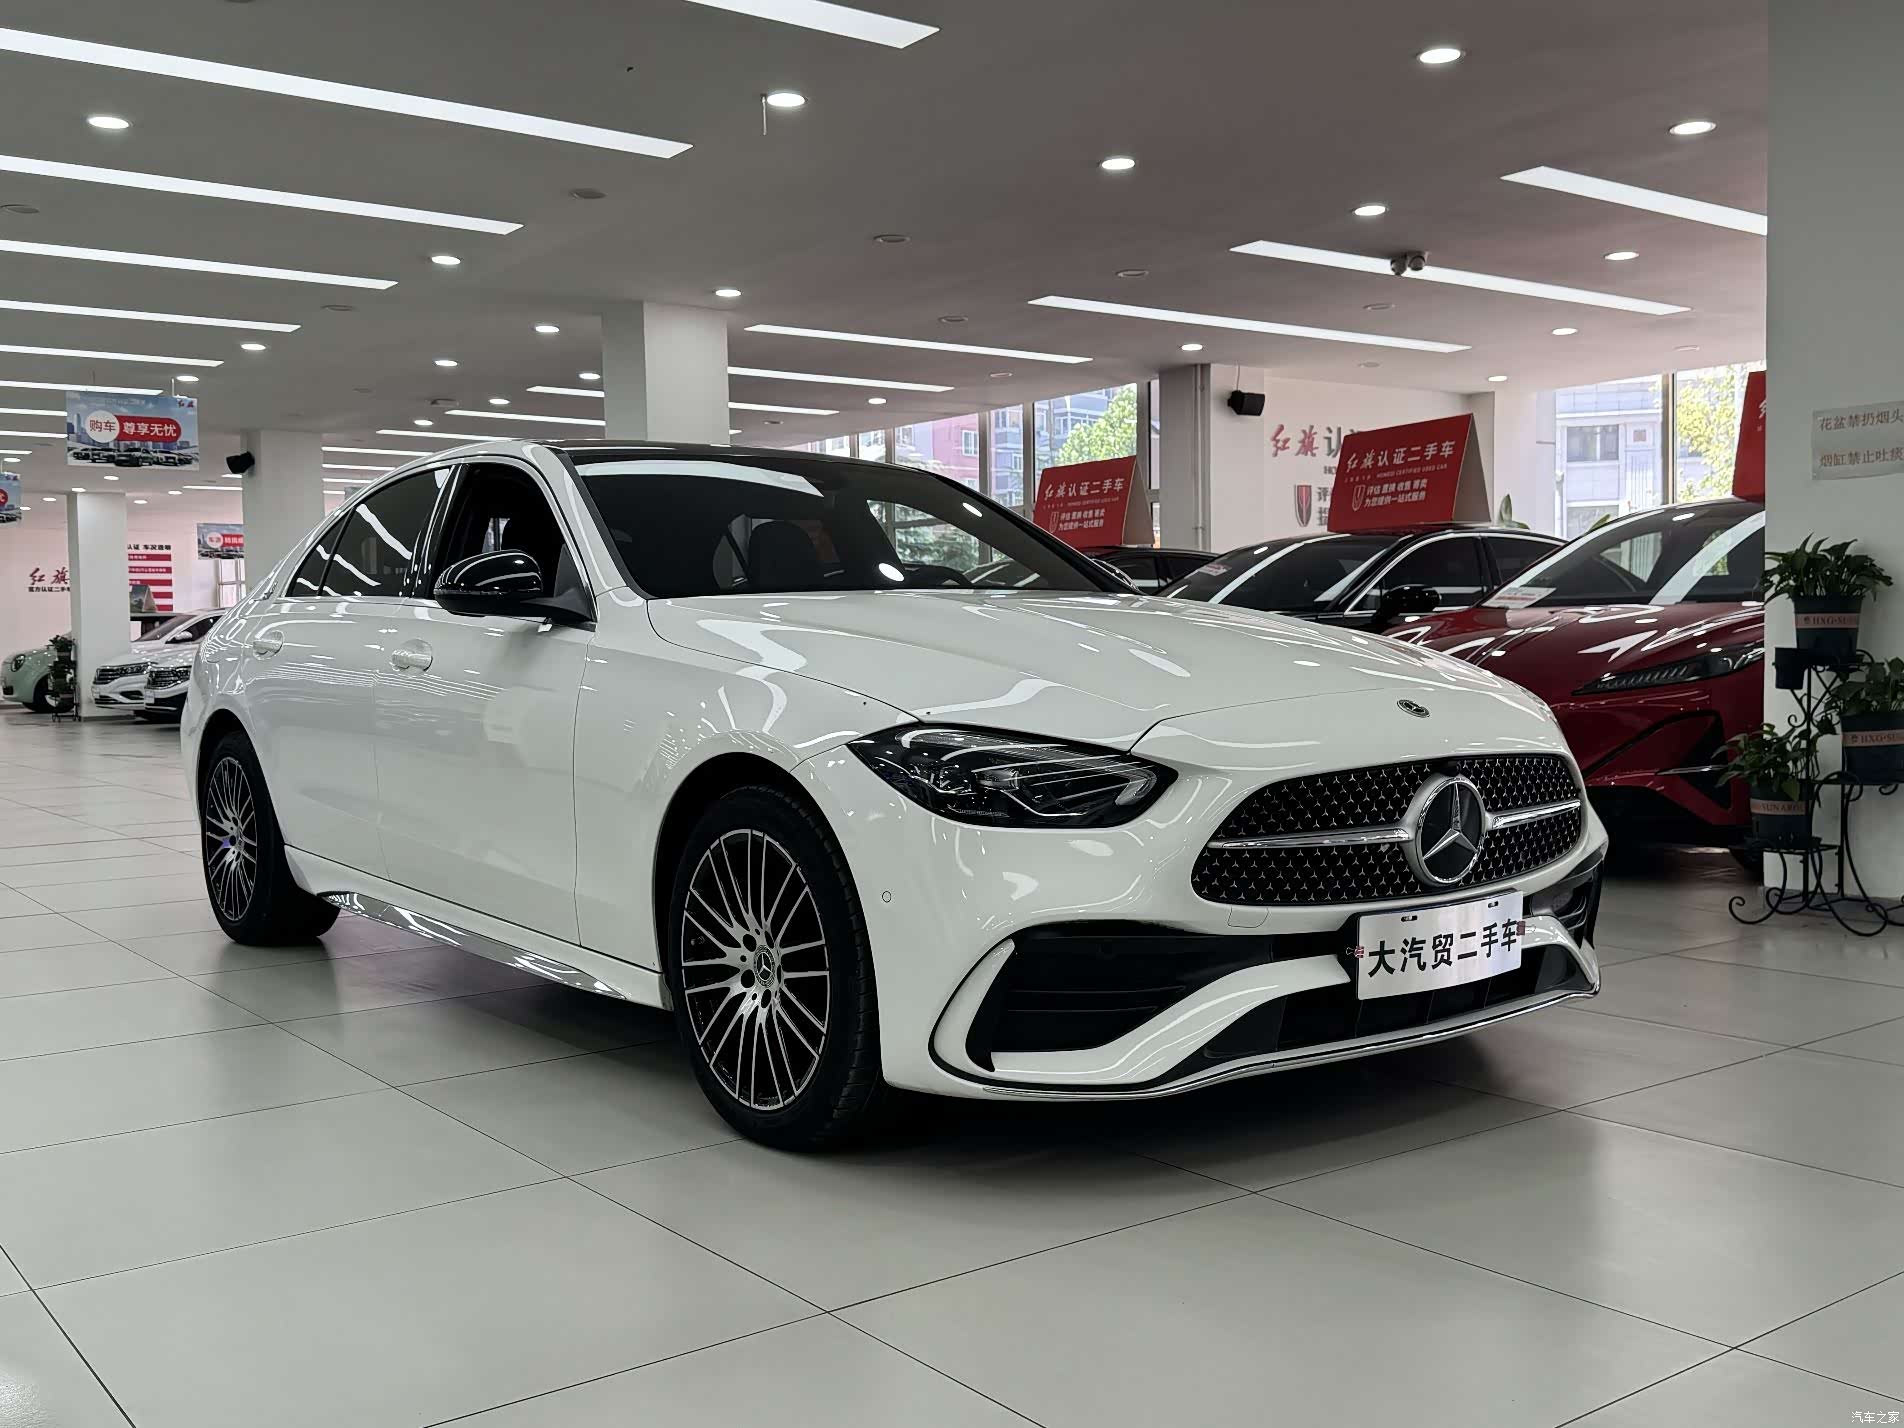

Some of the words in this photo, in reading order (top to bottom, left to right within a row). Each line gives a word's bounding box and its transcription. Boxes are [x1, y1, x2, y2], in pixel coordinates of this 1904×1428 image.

[89, 420, 116, 432] 购车
[123, 421, 177, 437] 尊享无忧
[1820, 408, 1904, 431] 花盆禁扔烟头
[1346, 440, 1456, 473] 红旗认证二手车
[1044, 478, 1125, 500] 红旗认证二手车
[1367, 918, 1518, 978] 大汽贸二手车
